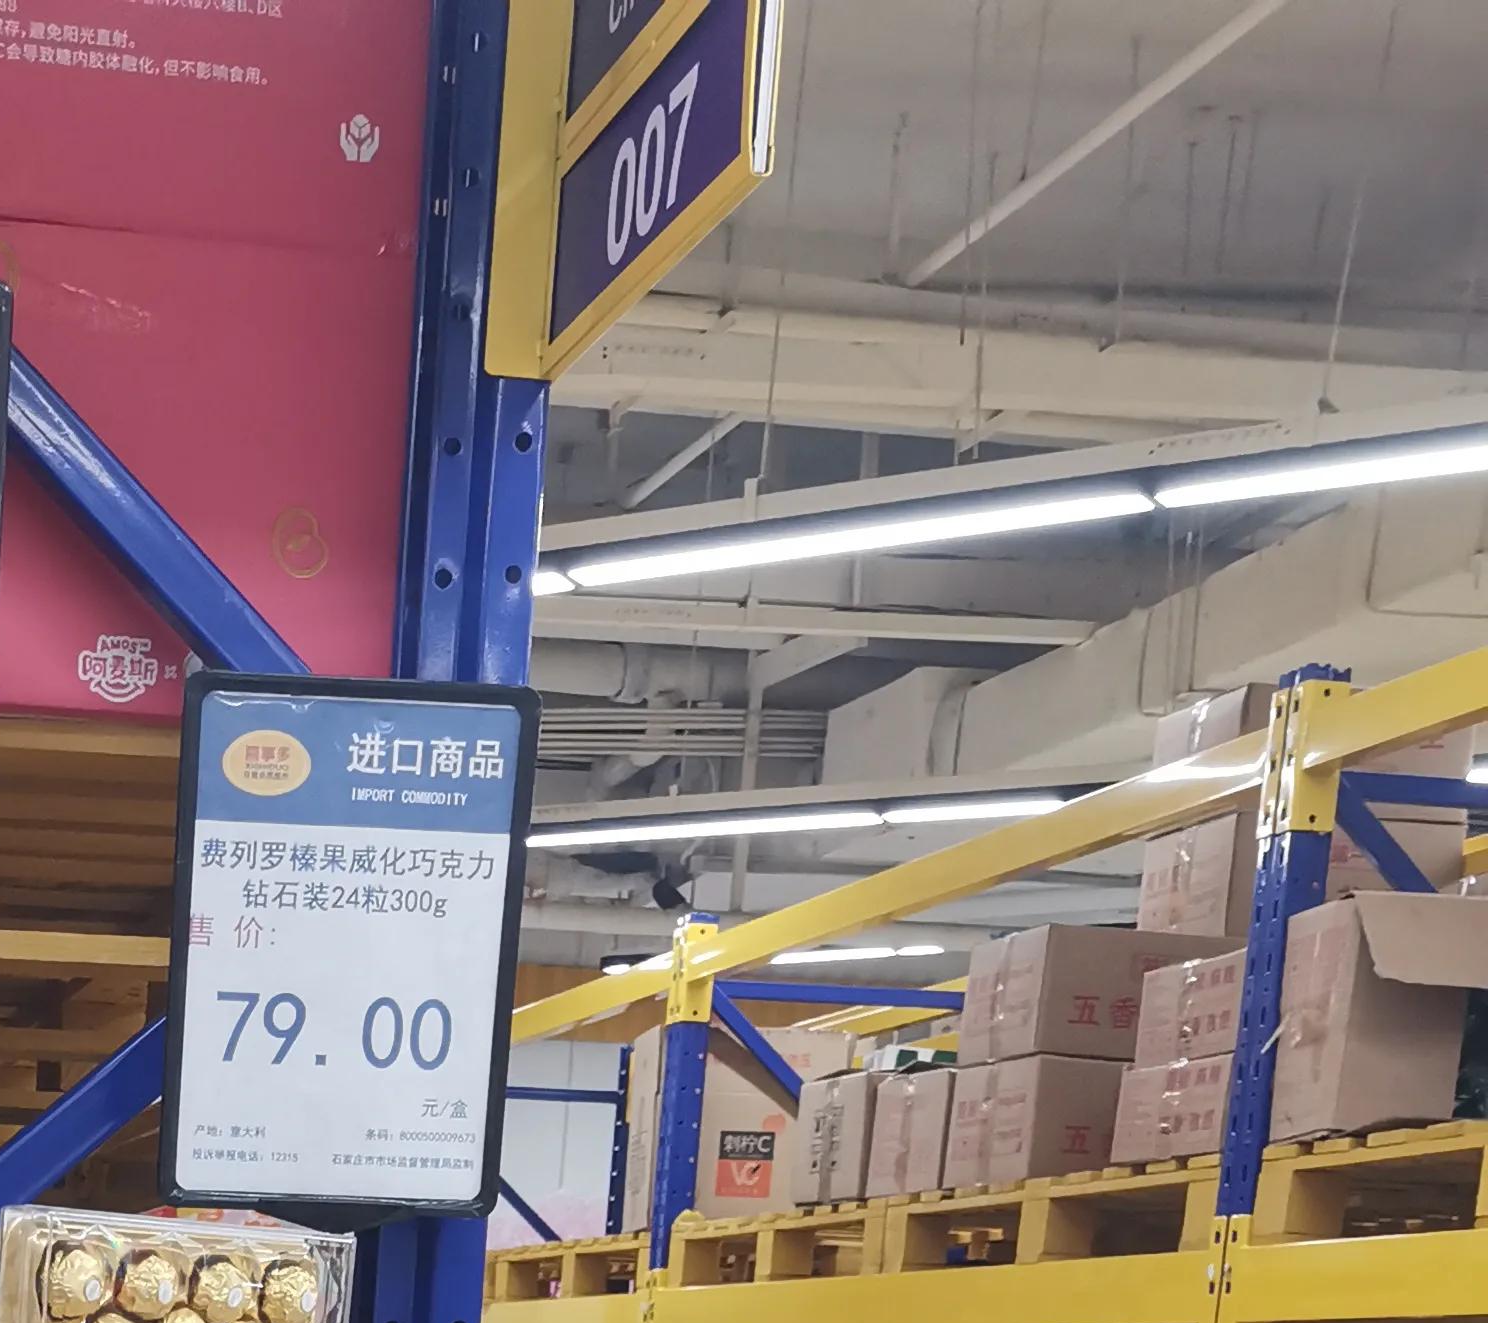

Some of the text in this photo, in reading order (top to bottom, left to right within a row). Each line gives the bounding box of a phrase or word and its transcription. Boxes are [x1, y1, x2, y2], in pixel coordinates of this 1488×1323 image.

[607, 61, 700, 265] 007
[347, 732, 504, 779] 进口商品
[351, 787, 394, 802] IMPORT
[402, 789, 468, 806] COMMODITY
[200, 838, 494, 880] 费列罗榛果威化巧克力
[243, 879, 448, 917] 钻石装24粒300g
[217, 990, 452, 1071] 79.00
[421, 1098, 468, 1118] 元/盒
